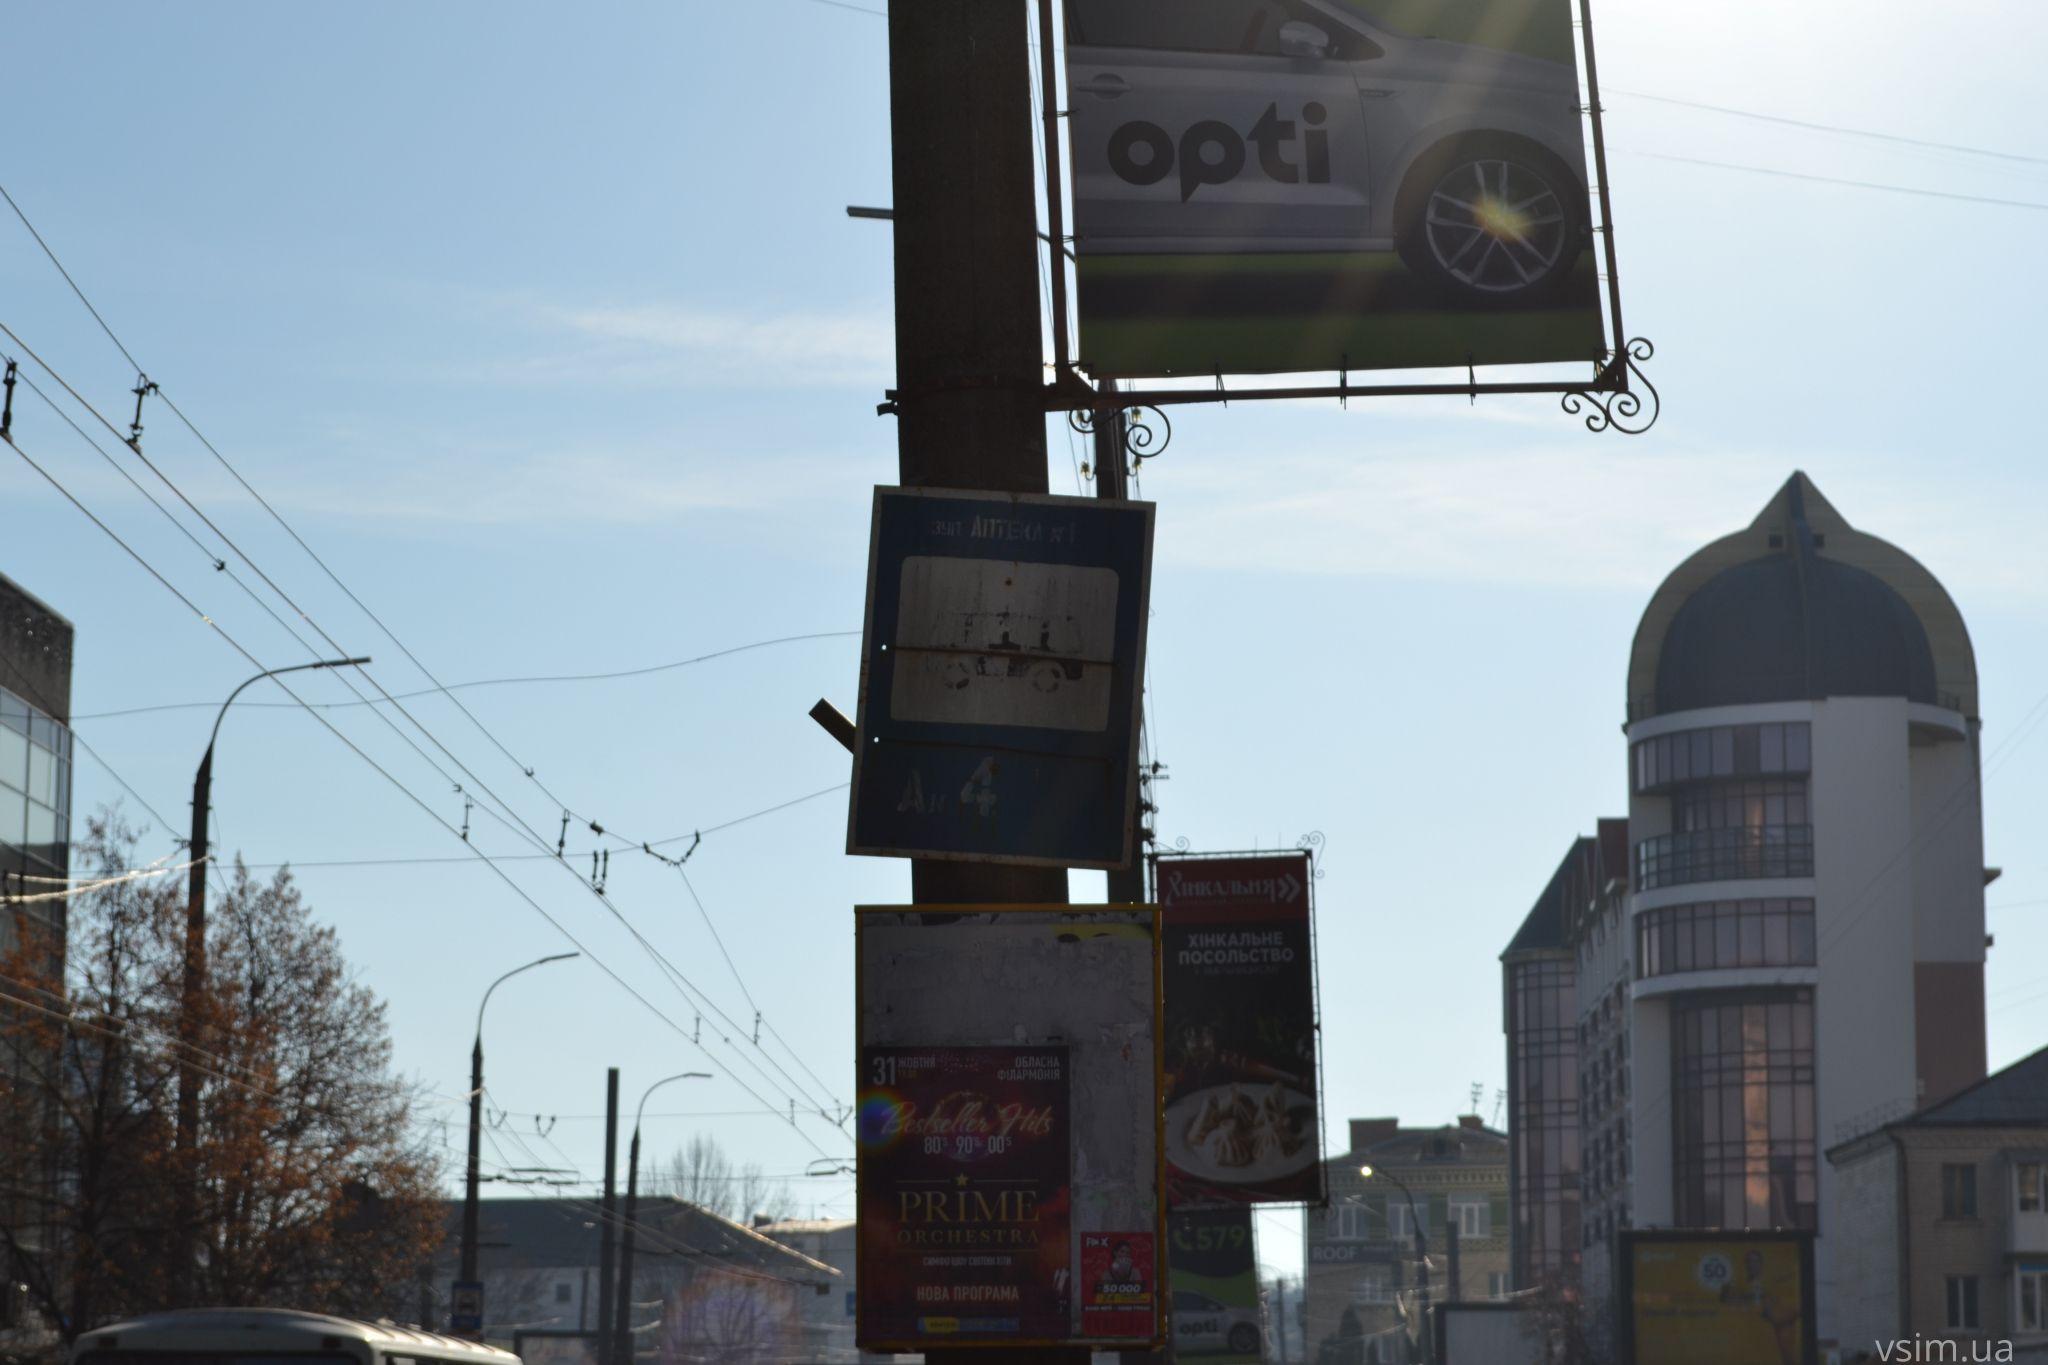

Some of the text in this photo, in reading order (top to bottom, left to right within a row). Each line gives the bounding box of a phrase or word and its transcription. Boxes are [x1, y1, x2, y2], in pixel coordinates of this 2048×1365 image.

[1107, 101, 1331, 204] opti
[1187, 931, 1284, 948] ХІНКАЛЬНЕ
[1178, 947, 1295, 965] ПОСОЛЬСТВО
[1015, 1055, 1060, 1068] ОБЛАСНА
[872, 1056, 896, 1085] 31
[897, 1056, 936, 1068] ЖОВТНЯ
[996, 1069, 1060, 1081] ФІЛАРМОНІЯ
[880, 1100, 1055, 1136] Bestseller Hits
[897, 1190, 1040, 1223] PRIME
[897, 1229, 1040, 1244] ORCHESTRA
[1196, 1225, 1247, 1251] 579
[1312, 1246, 1358, 1261] ROOF
[1703, 1263, 1727, 1280] 50
[916, 1285, 1020, 1302] НОВА ПРОГРАМА
